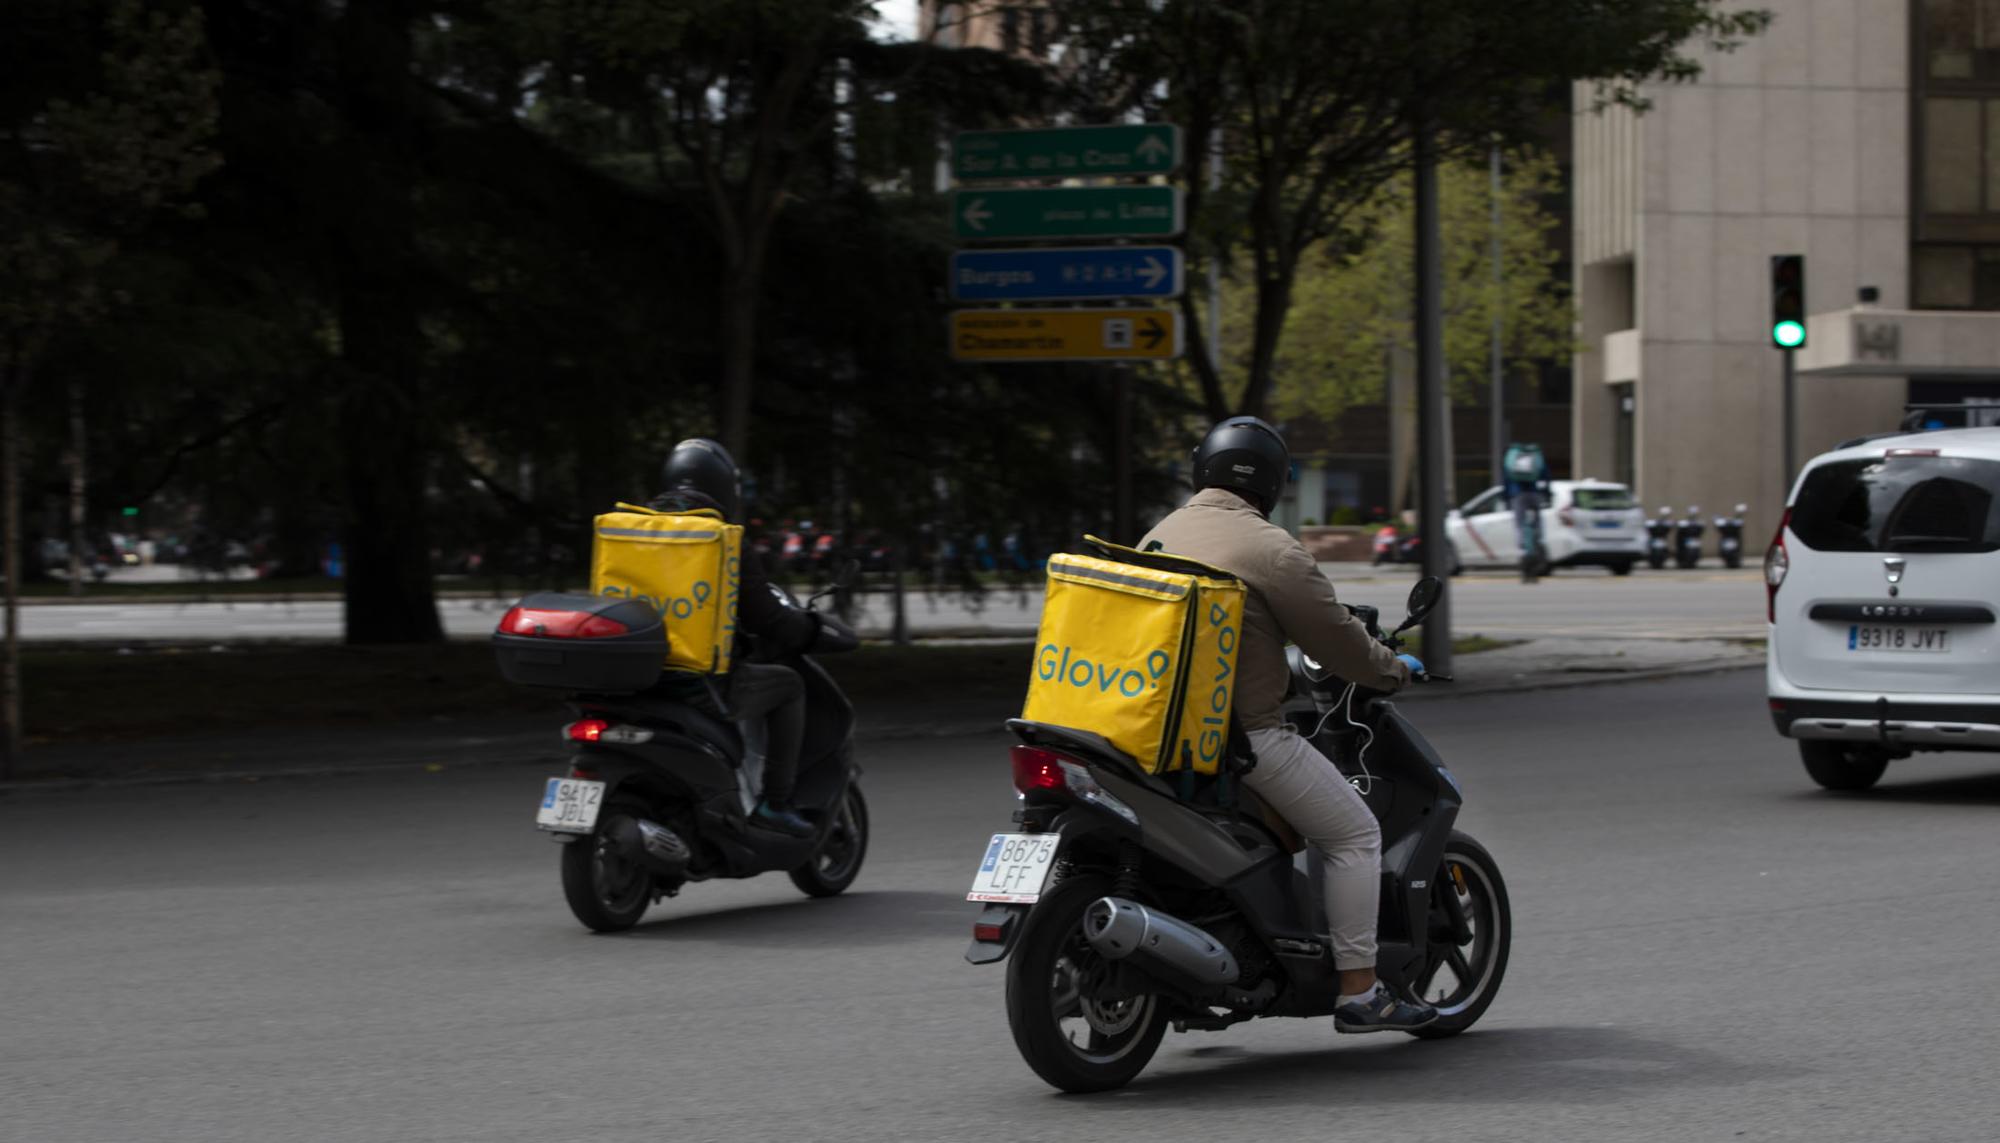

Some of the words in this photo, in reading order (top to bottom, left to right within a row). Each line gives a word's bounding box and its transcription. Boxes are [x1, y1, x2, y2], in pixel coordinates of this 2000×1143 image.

[960, 267, 1035, 286] Burgos
[1860, 628, 1905, 647] 9318
[1912, 629, 1948, 649] JVT
[1038, 644, 1145, 697] Glovo
[1199, 626, 1235, 763] Glovo
[1001, 839, 1053, 863] 8675
[990, 865, 1032, 889] LFF
